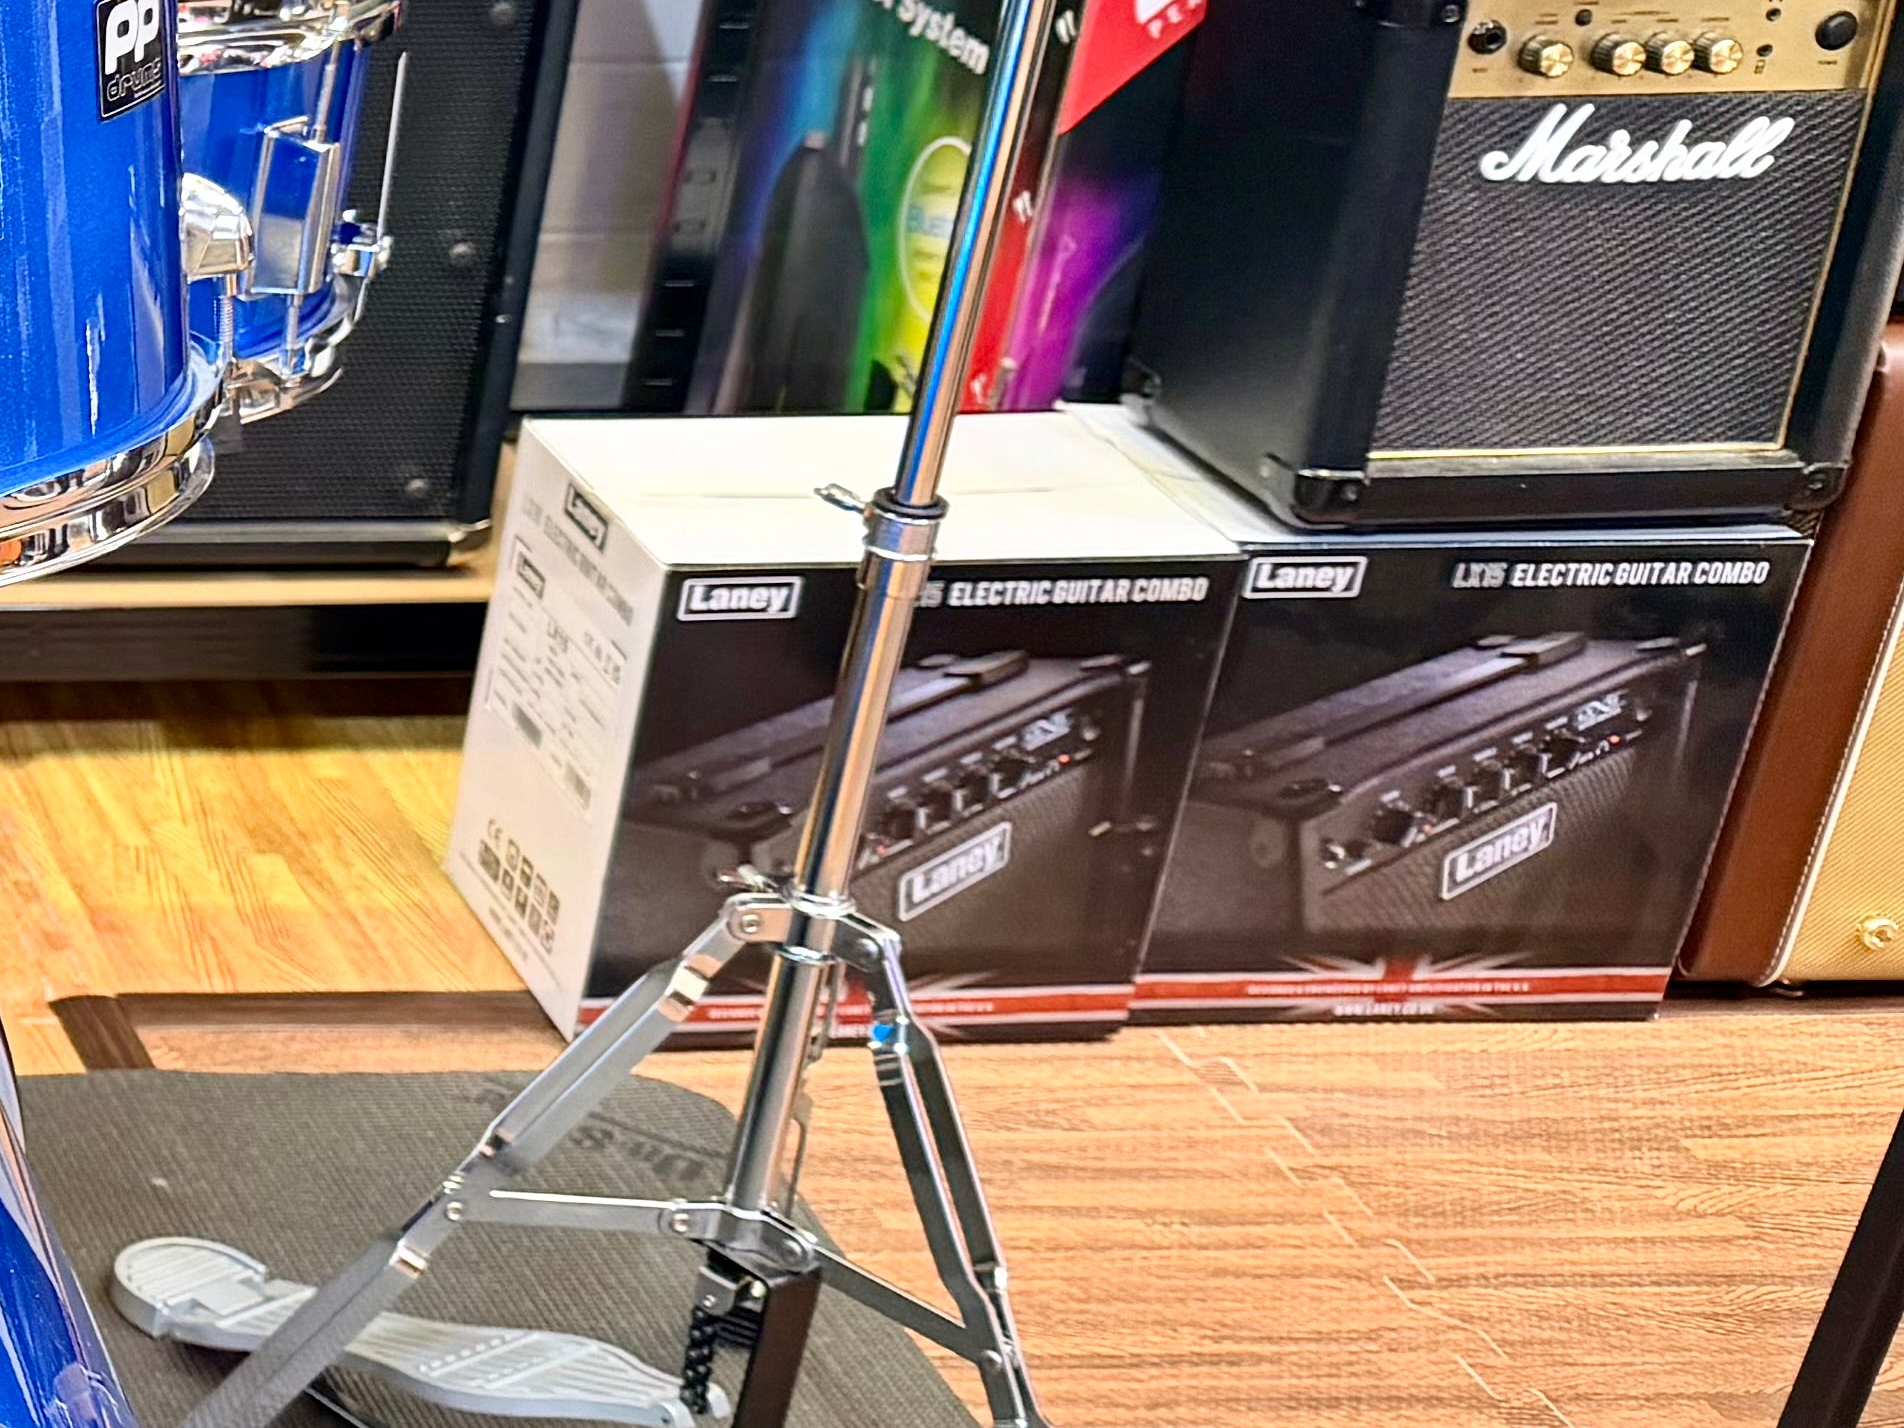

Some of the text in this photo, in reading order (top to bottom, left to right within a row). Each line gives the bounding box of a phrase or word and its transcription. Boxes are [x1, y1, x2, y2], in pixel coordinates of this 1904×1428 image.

[1479, 102, 1795, 183] Marshall
[1254, 563, 1355, 594] Laney
[1451, 561, 1771, 589] LX15 ELECTRIC GUITAR COMBO
[690, 583, 789, 614] Laney
[947, 580, 1054, 608] ELECTRIC
[1051, 579, 1134, 606] GUITAR
[1132, 576, 1211, 603] COMBO
[1453, 818, 1546, 883] Laney
[910, 834, 1003, 904] Laney
